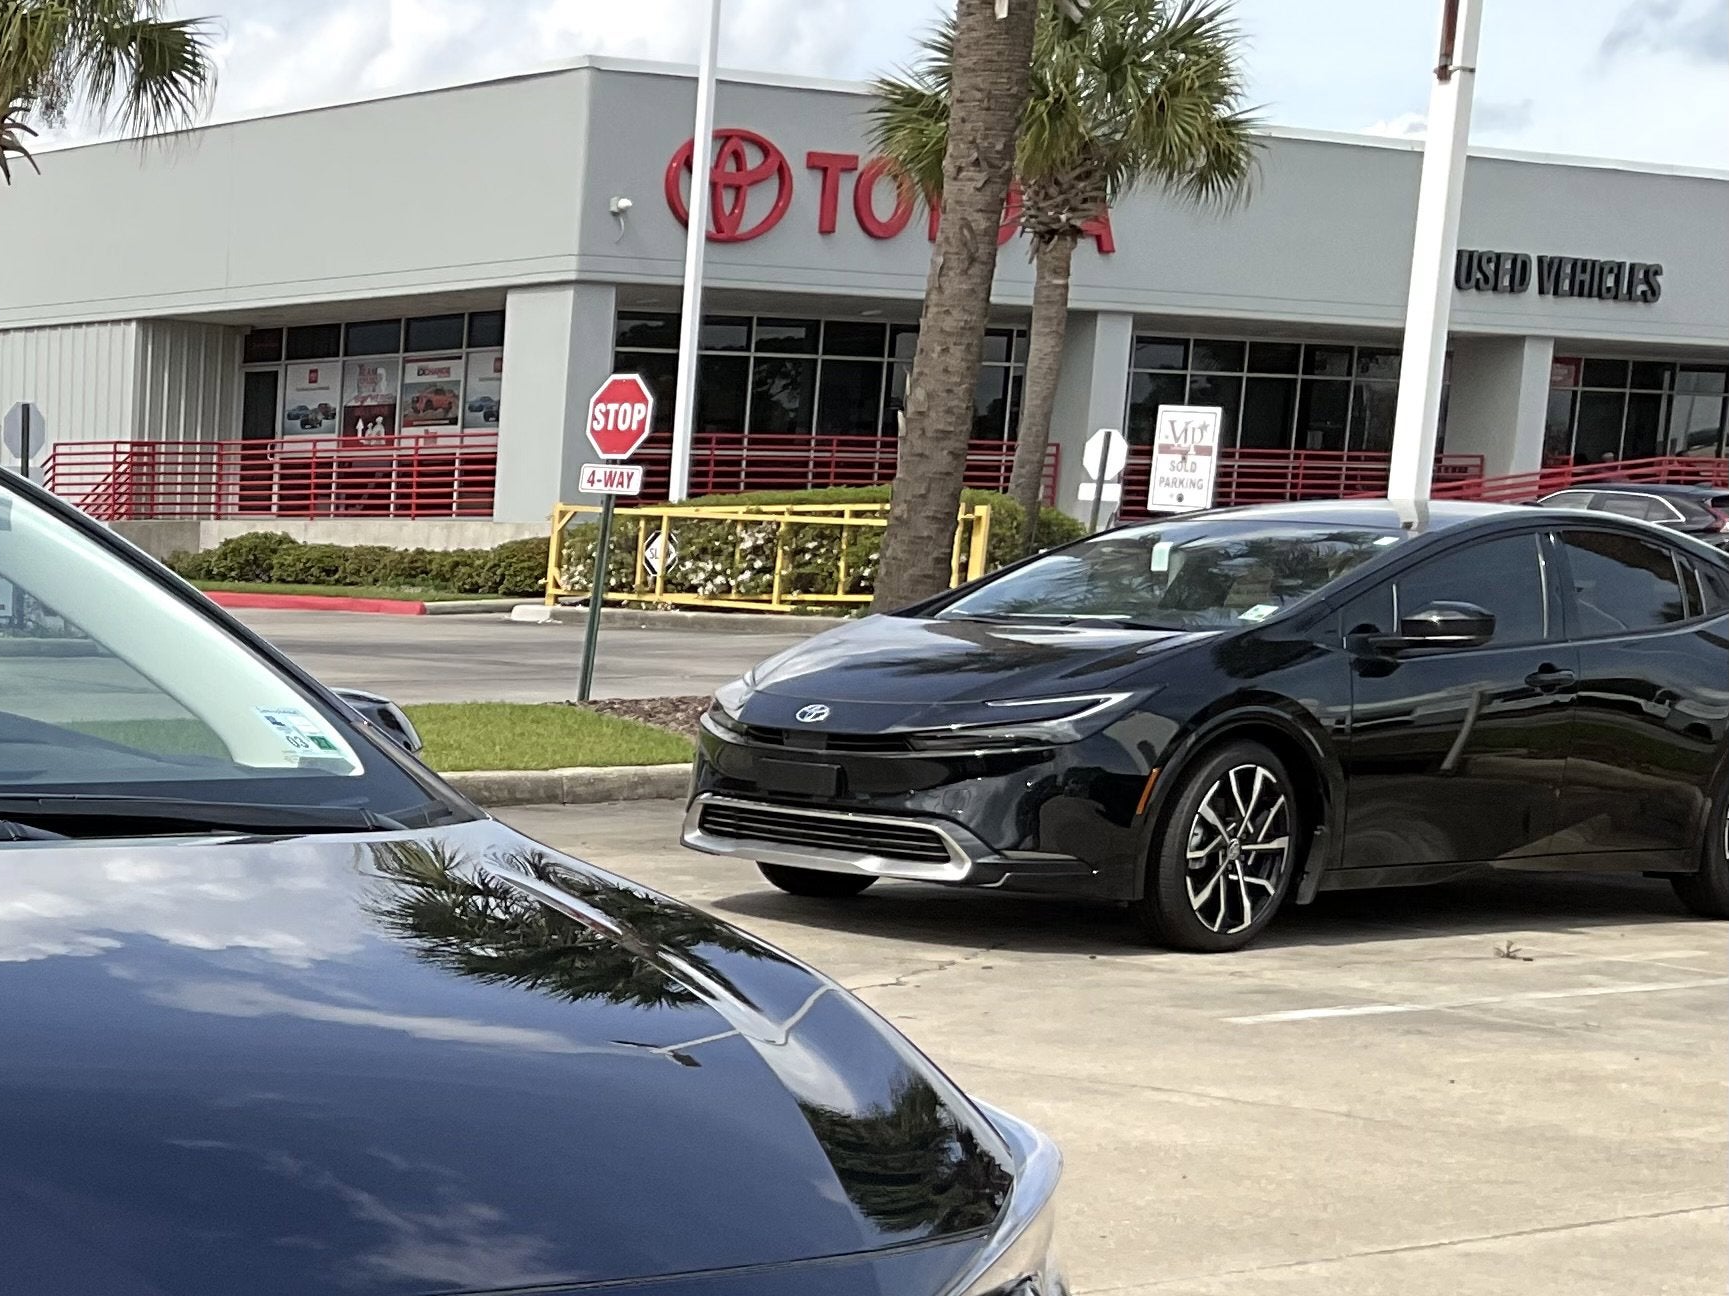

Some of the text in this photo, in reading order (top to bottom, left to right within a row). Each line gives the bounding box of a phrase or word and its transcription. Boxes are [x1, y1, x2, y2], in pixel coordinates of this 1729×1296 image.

[806, 151, 1116, 254] TOA
[1455, 249, 1663, 303] USED VEHICLES
[592, 402, 646, 432] STOP
[1169, 460, 1197, 473] SOLD
[587, 469, 634, 490] 4-WAY
[1159, 476, 1204, 490] PARKING
[286, 736, 309, 748] 03
